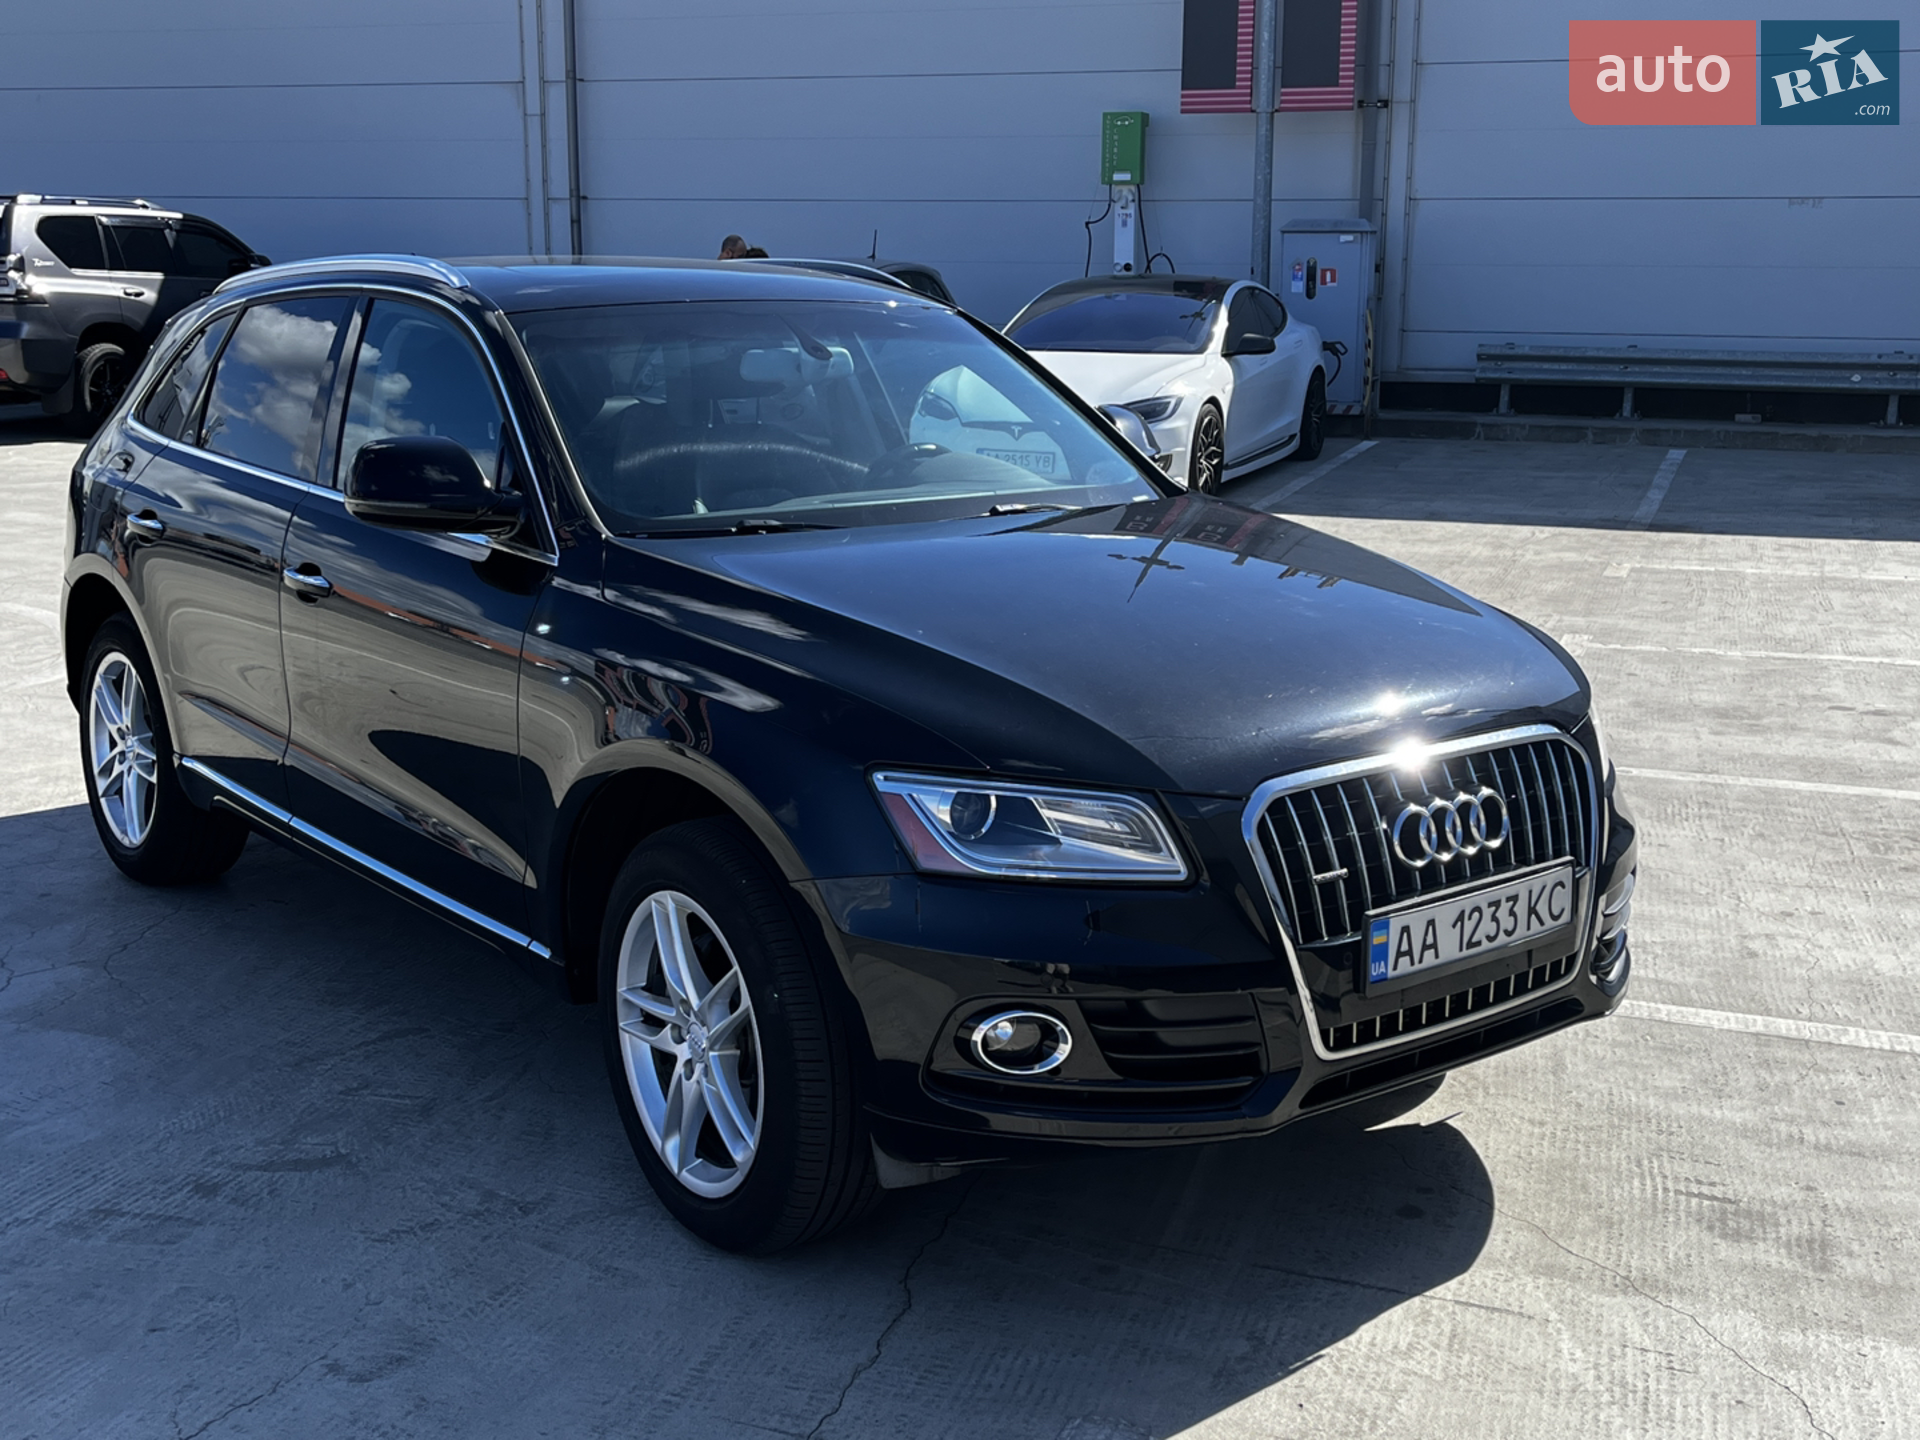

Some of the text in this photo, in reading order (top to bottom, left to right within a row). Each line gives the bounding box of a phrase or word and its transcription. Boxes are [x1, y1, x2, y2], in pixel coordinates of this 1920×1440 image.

[1392, 880, 1567, 972] AA 1233 KC
[1371, 960, 1388, 977] UA
